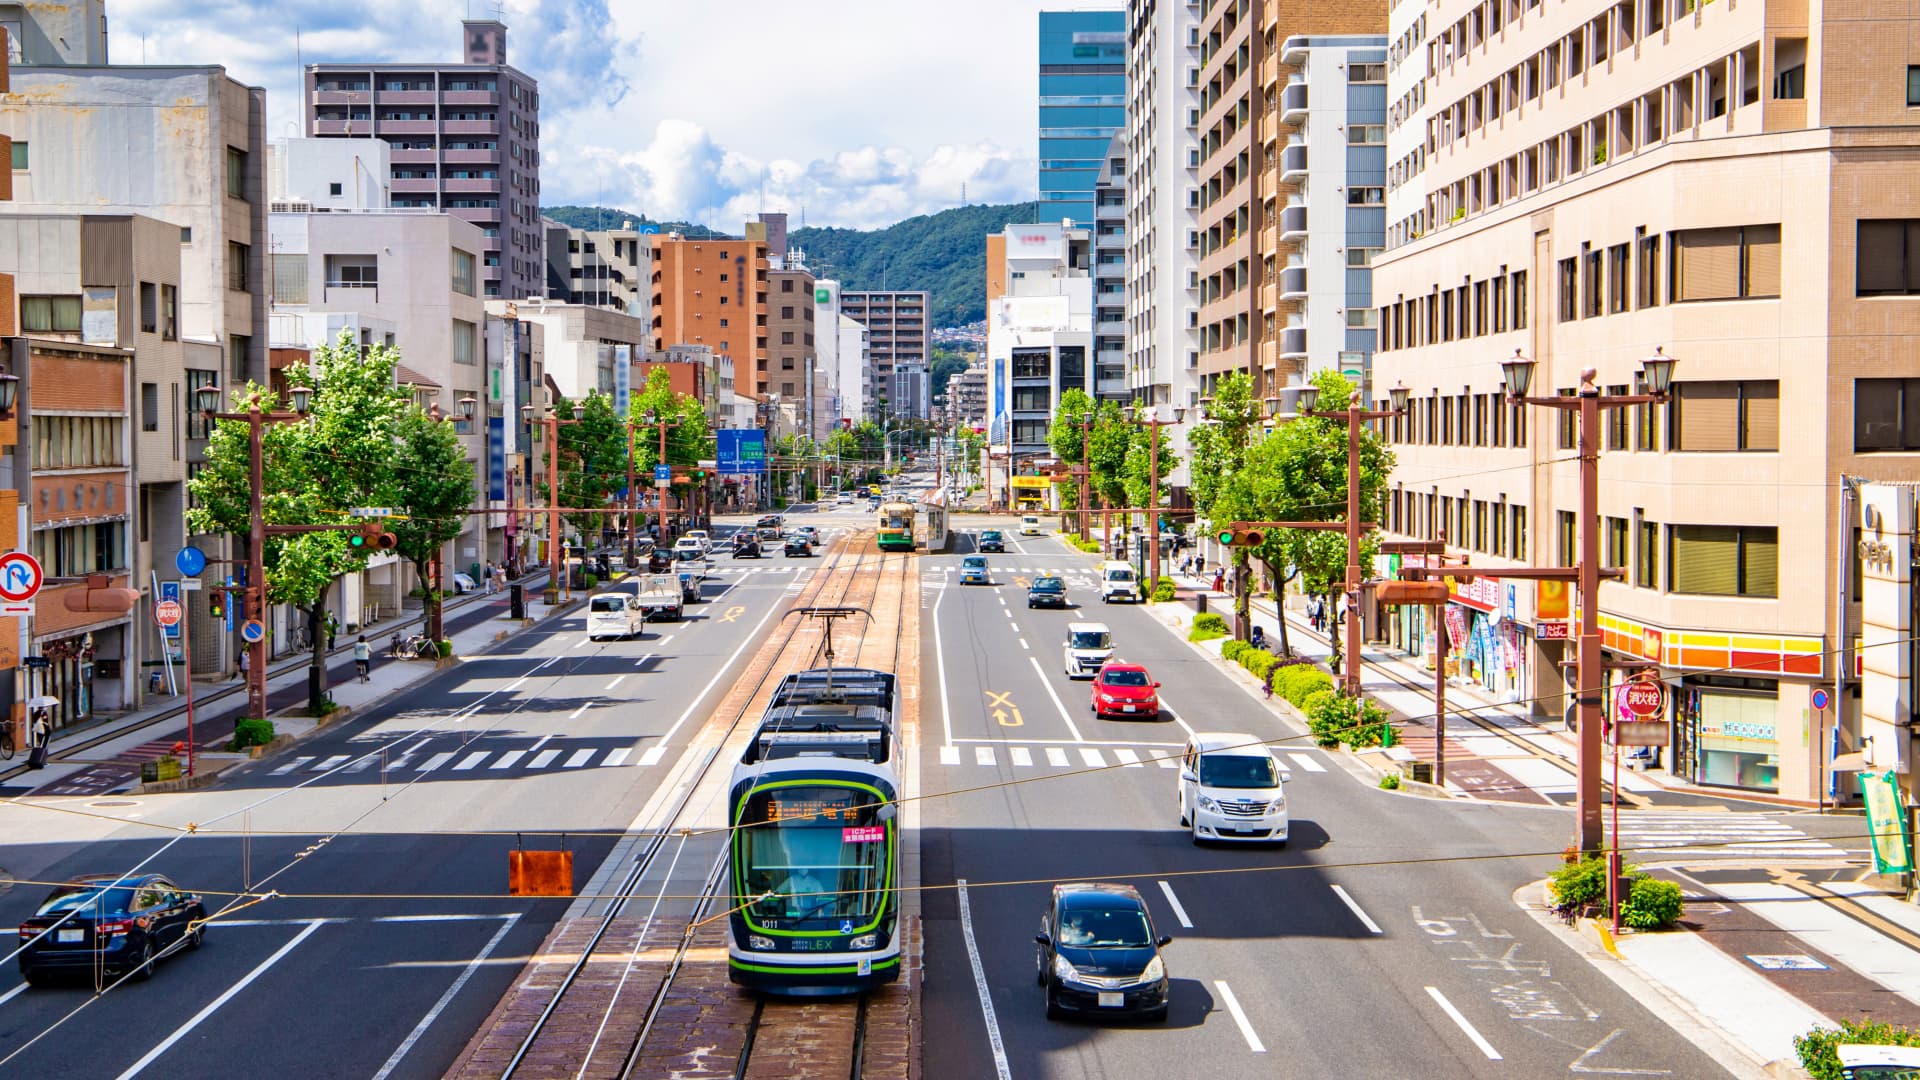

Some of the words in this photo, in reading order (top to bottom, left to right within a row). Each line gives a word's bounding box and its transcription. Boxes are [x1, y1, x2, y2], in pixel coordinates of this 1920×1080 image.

[1547, 625, 1568, 637] たばこ
[1629, 692, 1659, 706] 消火栓
[762, 920, 778, 929] 1011
[809, 940, 832, 950] LEX
